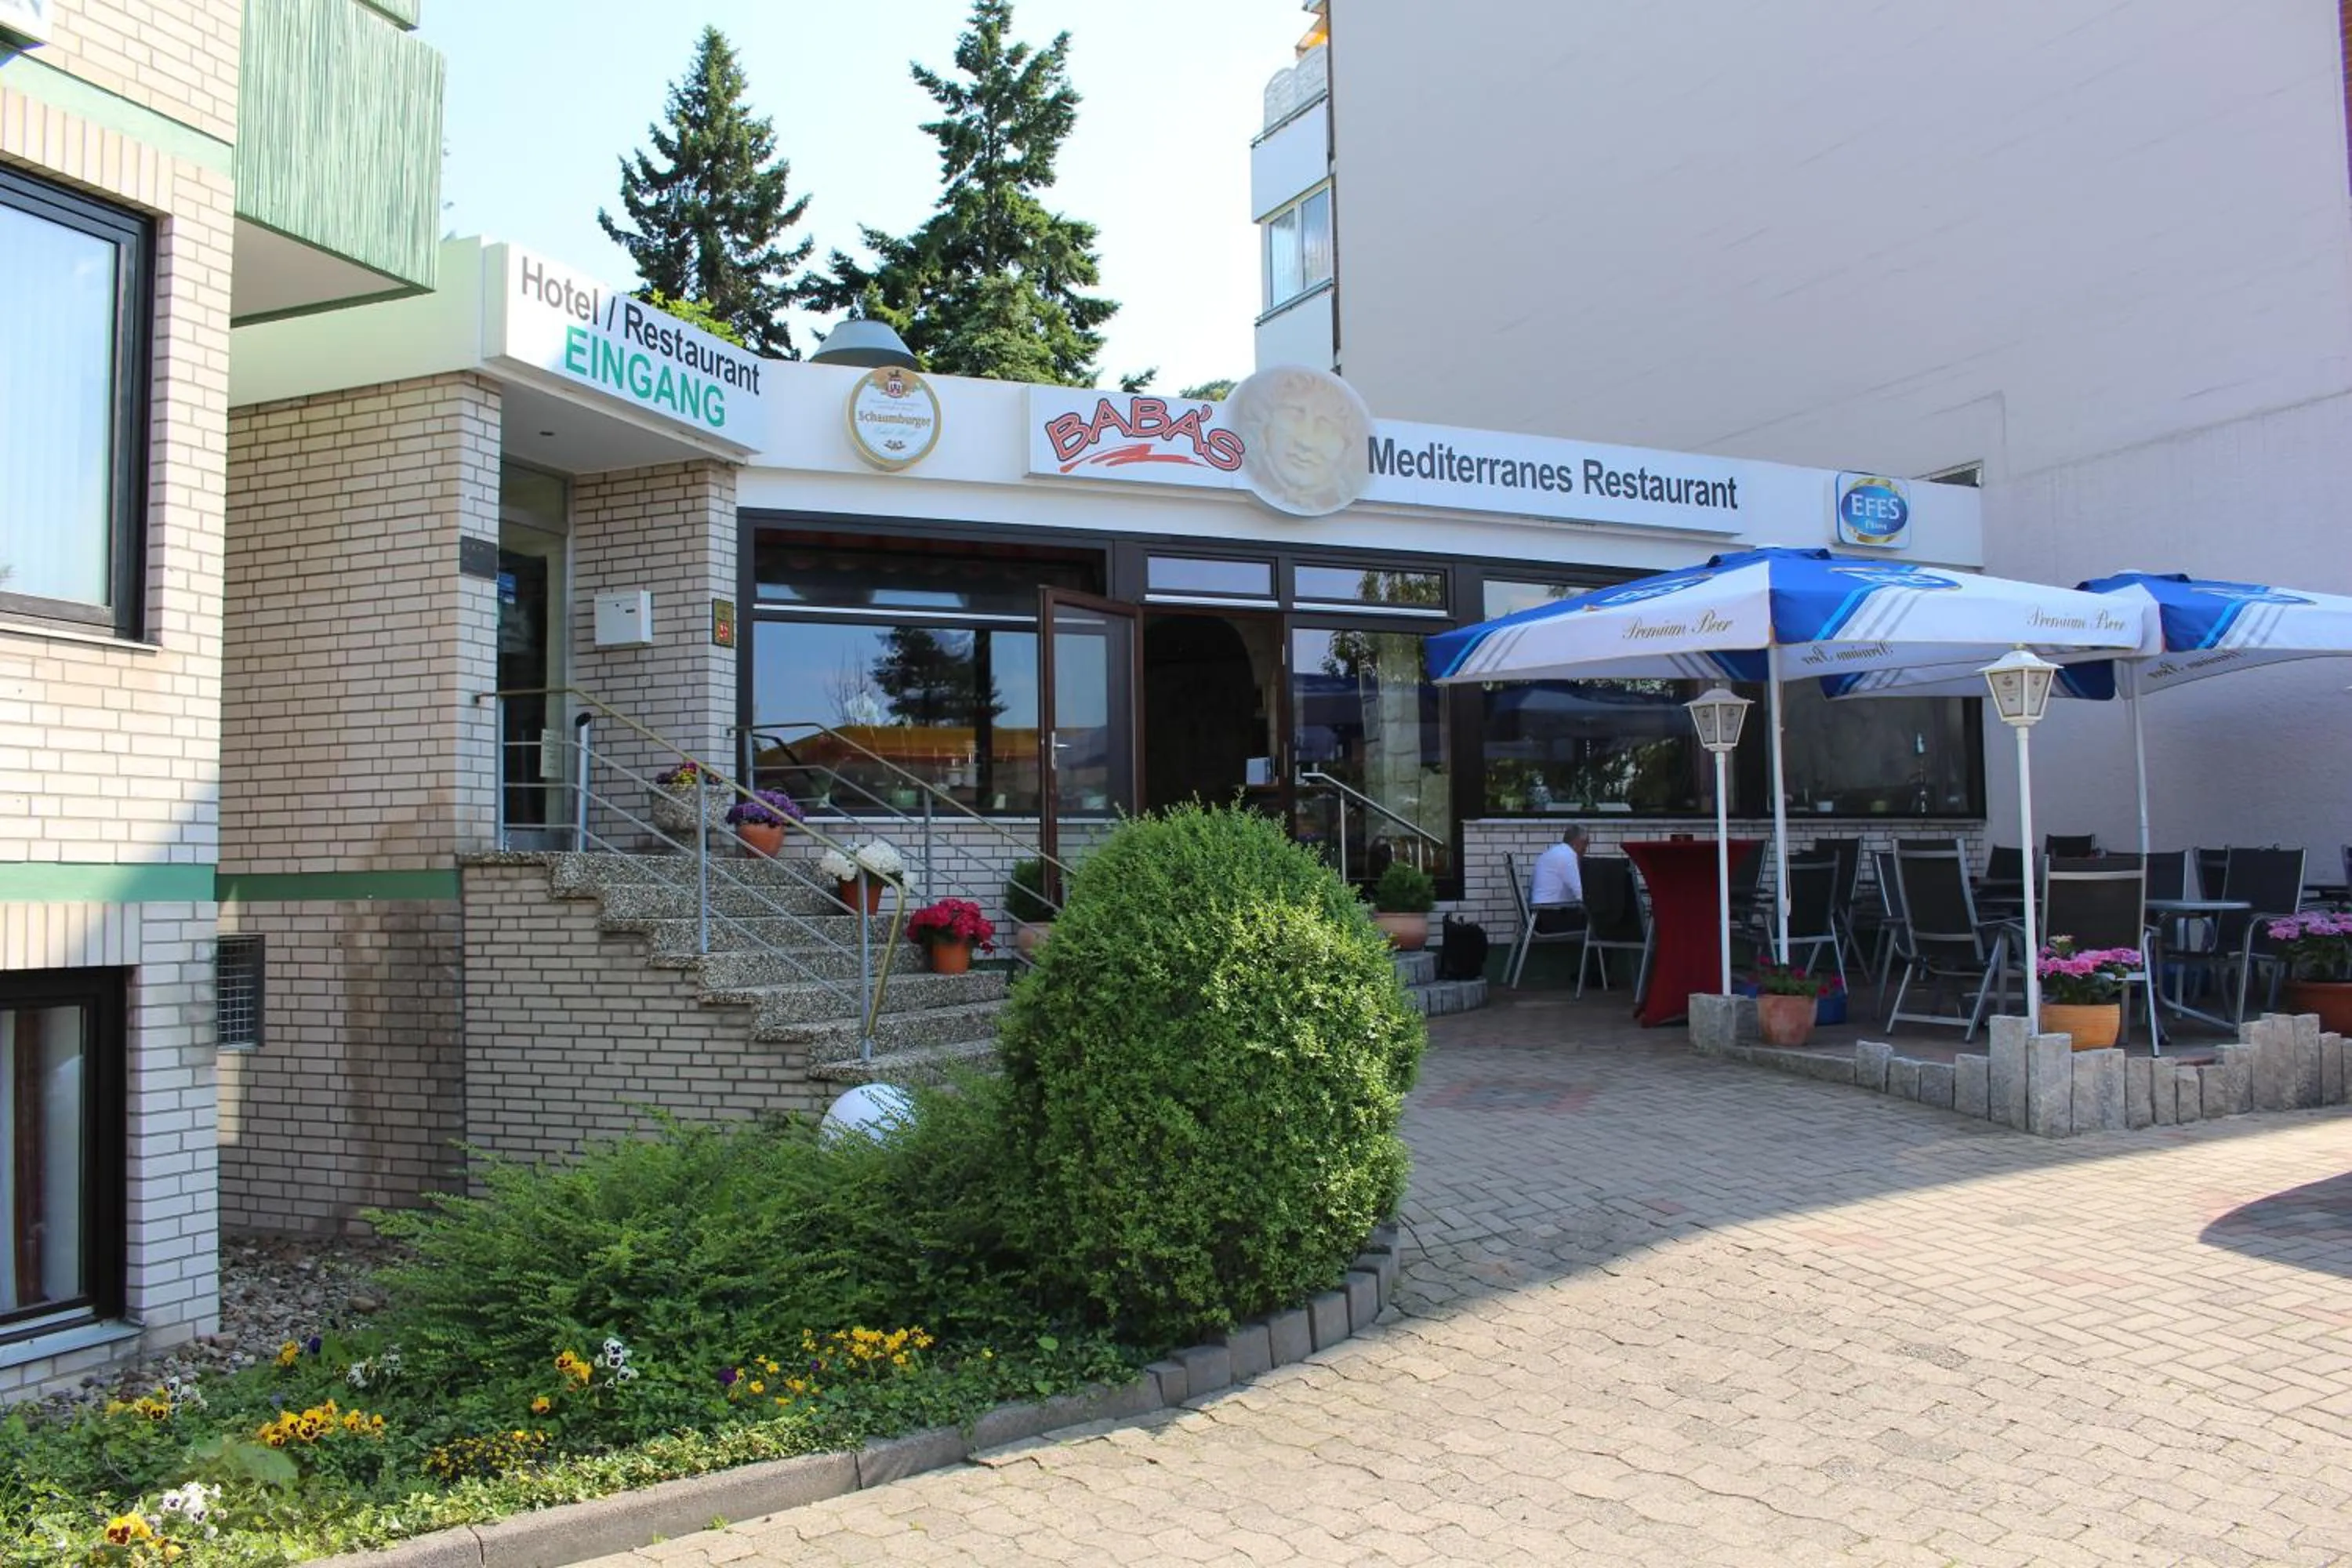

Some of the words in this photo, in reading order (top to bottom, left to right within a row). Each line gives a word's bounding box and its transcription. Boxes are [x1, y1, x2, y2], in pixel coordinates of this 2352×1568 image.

[521, 256, 599, 326] Hotel
[624, 302, 760, 396] Restaurant
[564, 325, 726, 428] EINGANG
[1044, 397, 1246, 471] BABA'S
[1367, 436, 1573, 493] Mediterranes
[1582, 458, 1738, 510] Restaurant
[1850, 493, 1900, 520] EFES
[1622, 616, 1687, 640] Premium
[1691, 608, 1733, 633] Beer
